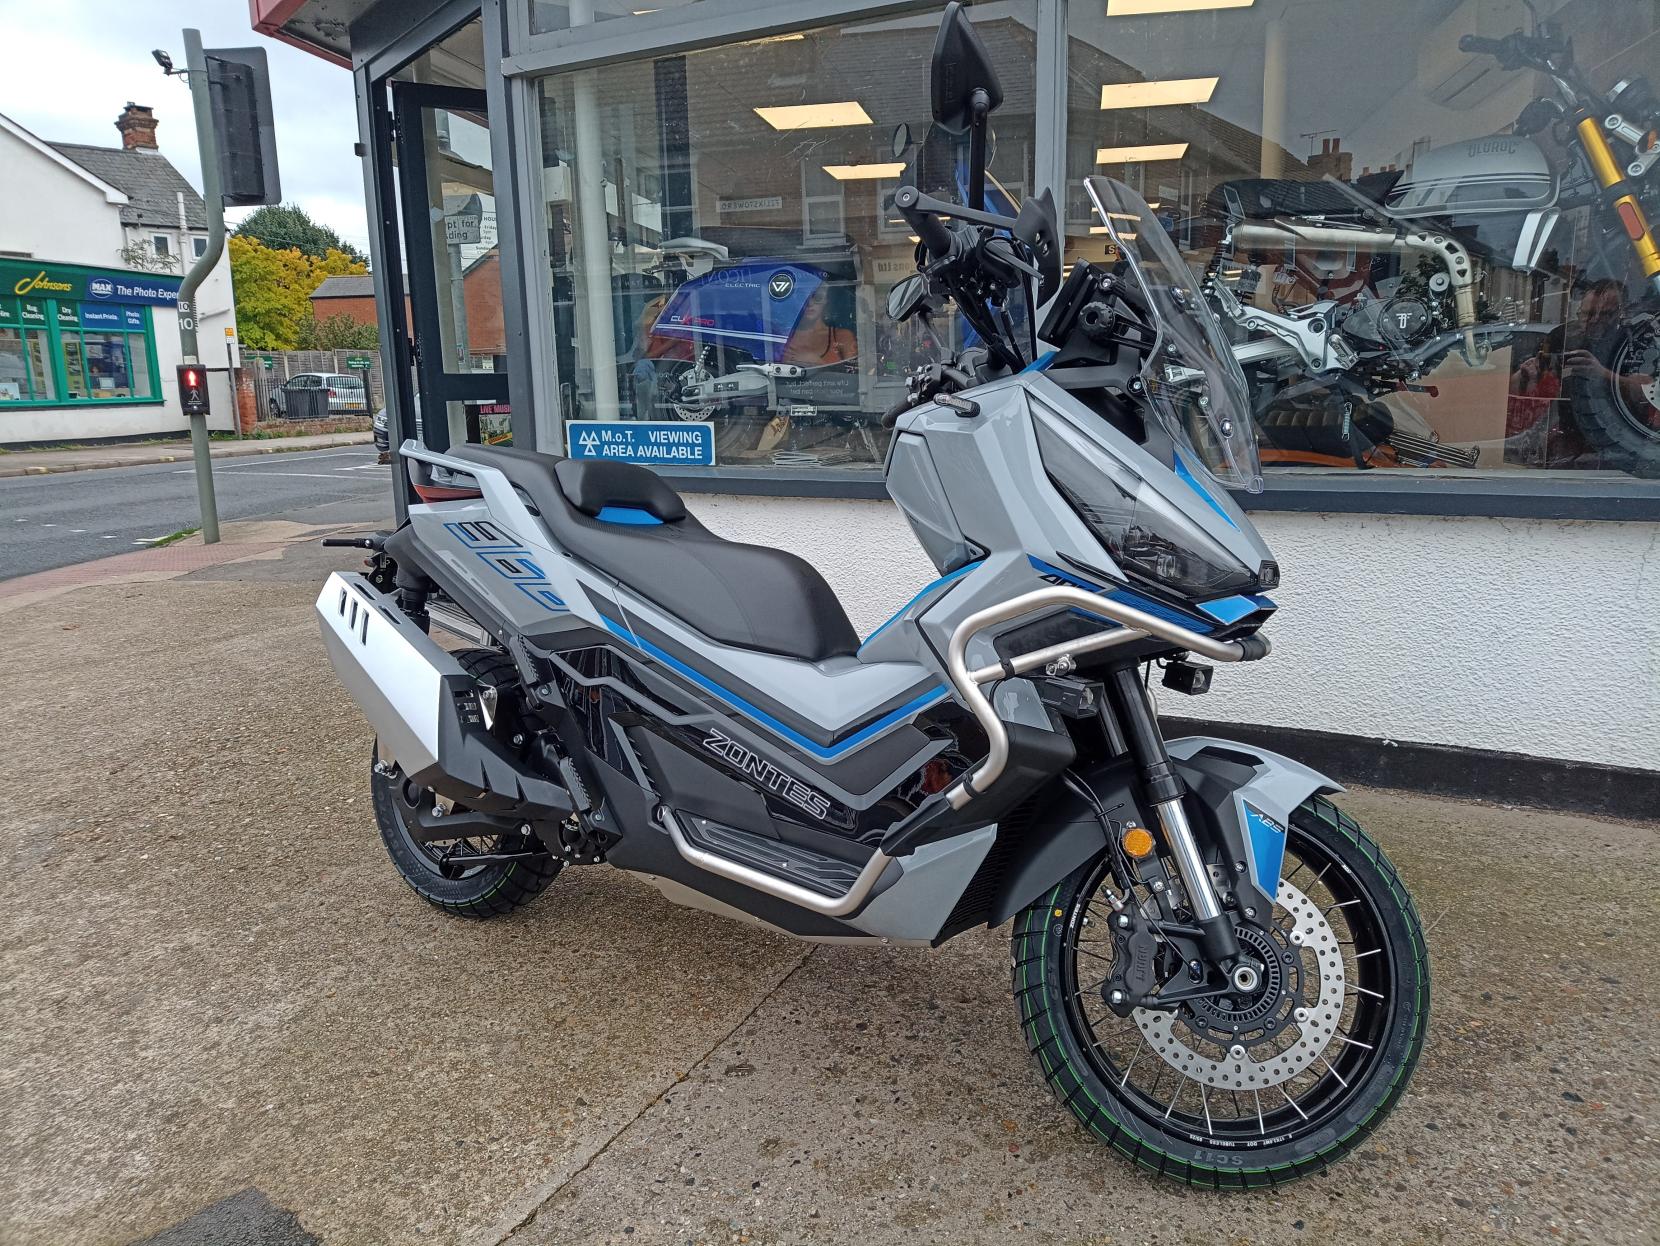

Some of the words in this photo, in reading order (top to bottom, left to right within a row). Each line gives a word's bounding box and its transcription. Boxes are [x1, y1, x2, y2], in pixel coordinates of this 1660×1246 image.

[462, 220, 474, 228] for
[14, 270, 72, 295] Johnsons
[91, 282, 112, 292] MAX
[116, 285, 132, 296] The
[134, 286, 156, 297] Photo
[158, 289, 179, 300] Expe
[84, 312, 102, 320] Instant
[180, 318, 193, 330] 10
[480, 405, 492, 413] LIVE
[602, 430, 635, 442] M.o.T.
[648, 430, 702, 444] VIEWING
[602, 445, 634, 457] AREA
[637, 445, 702, 458] AVAILABLE
[702, 728, 830, 820] ZONTES
[1250, 814, 1284, 834] ABS
